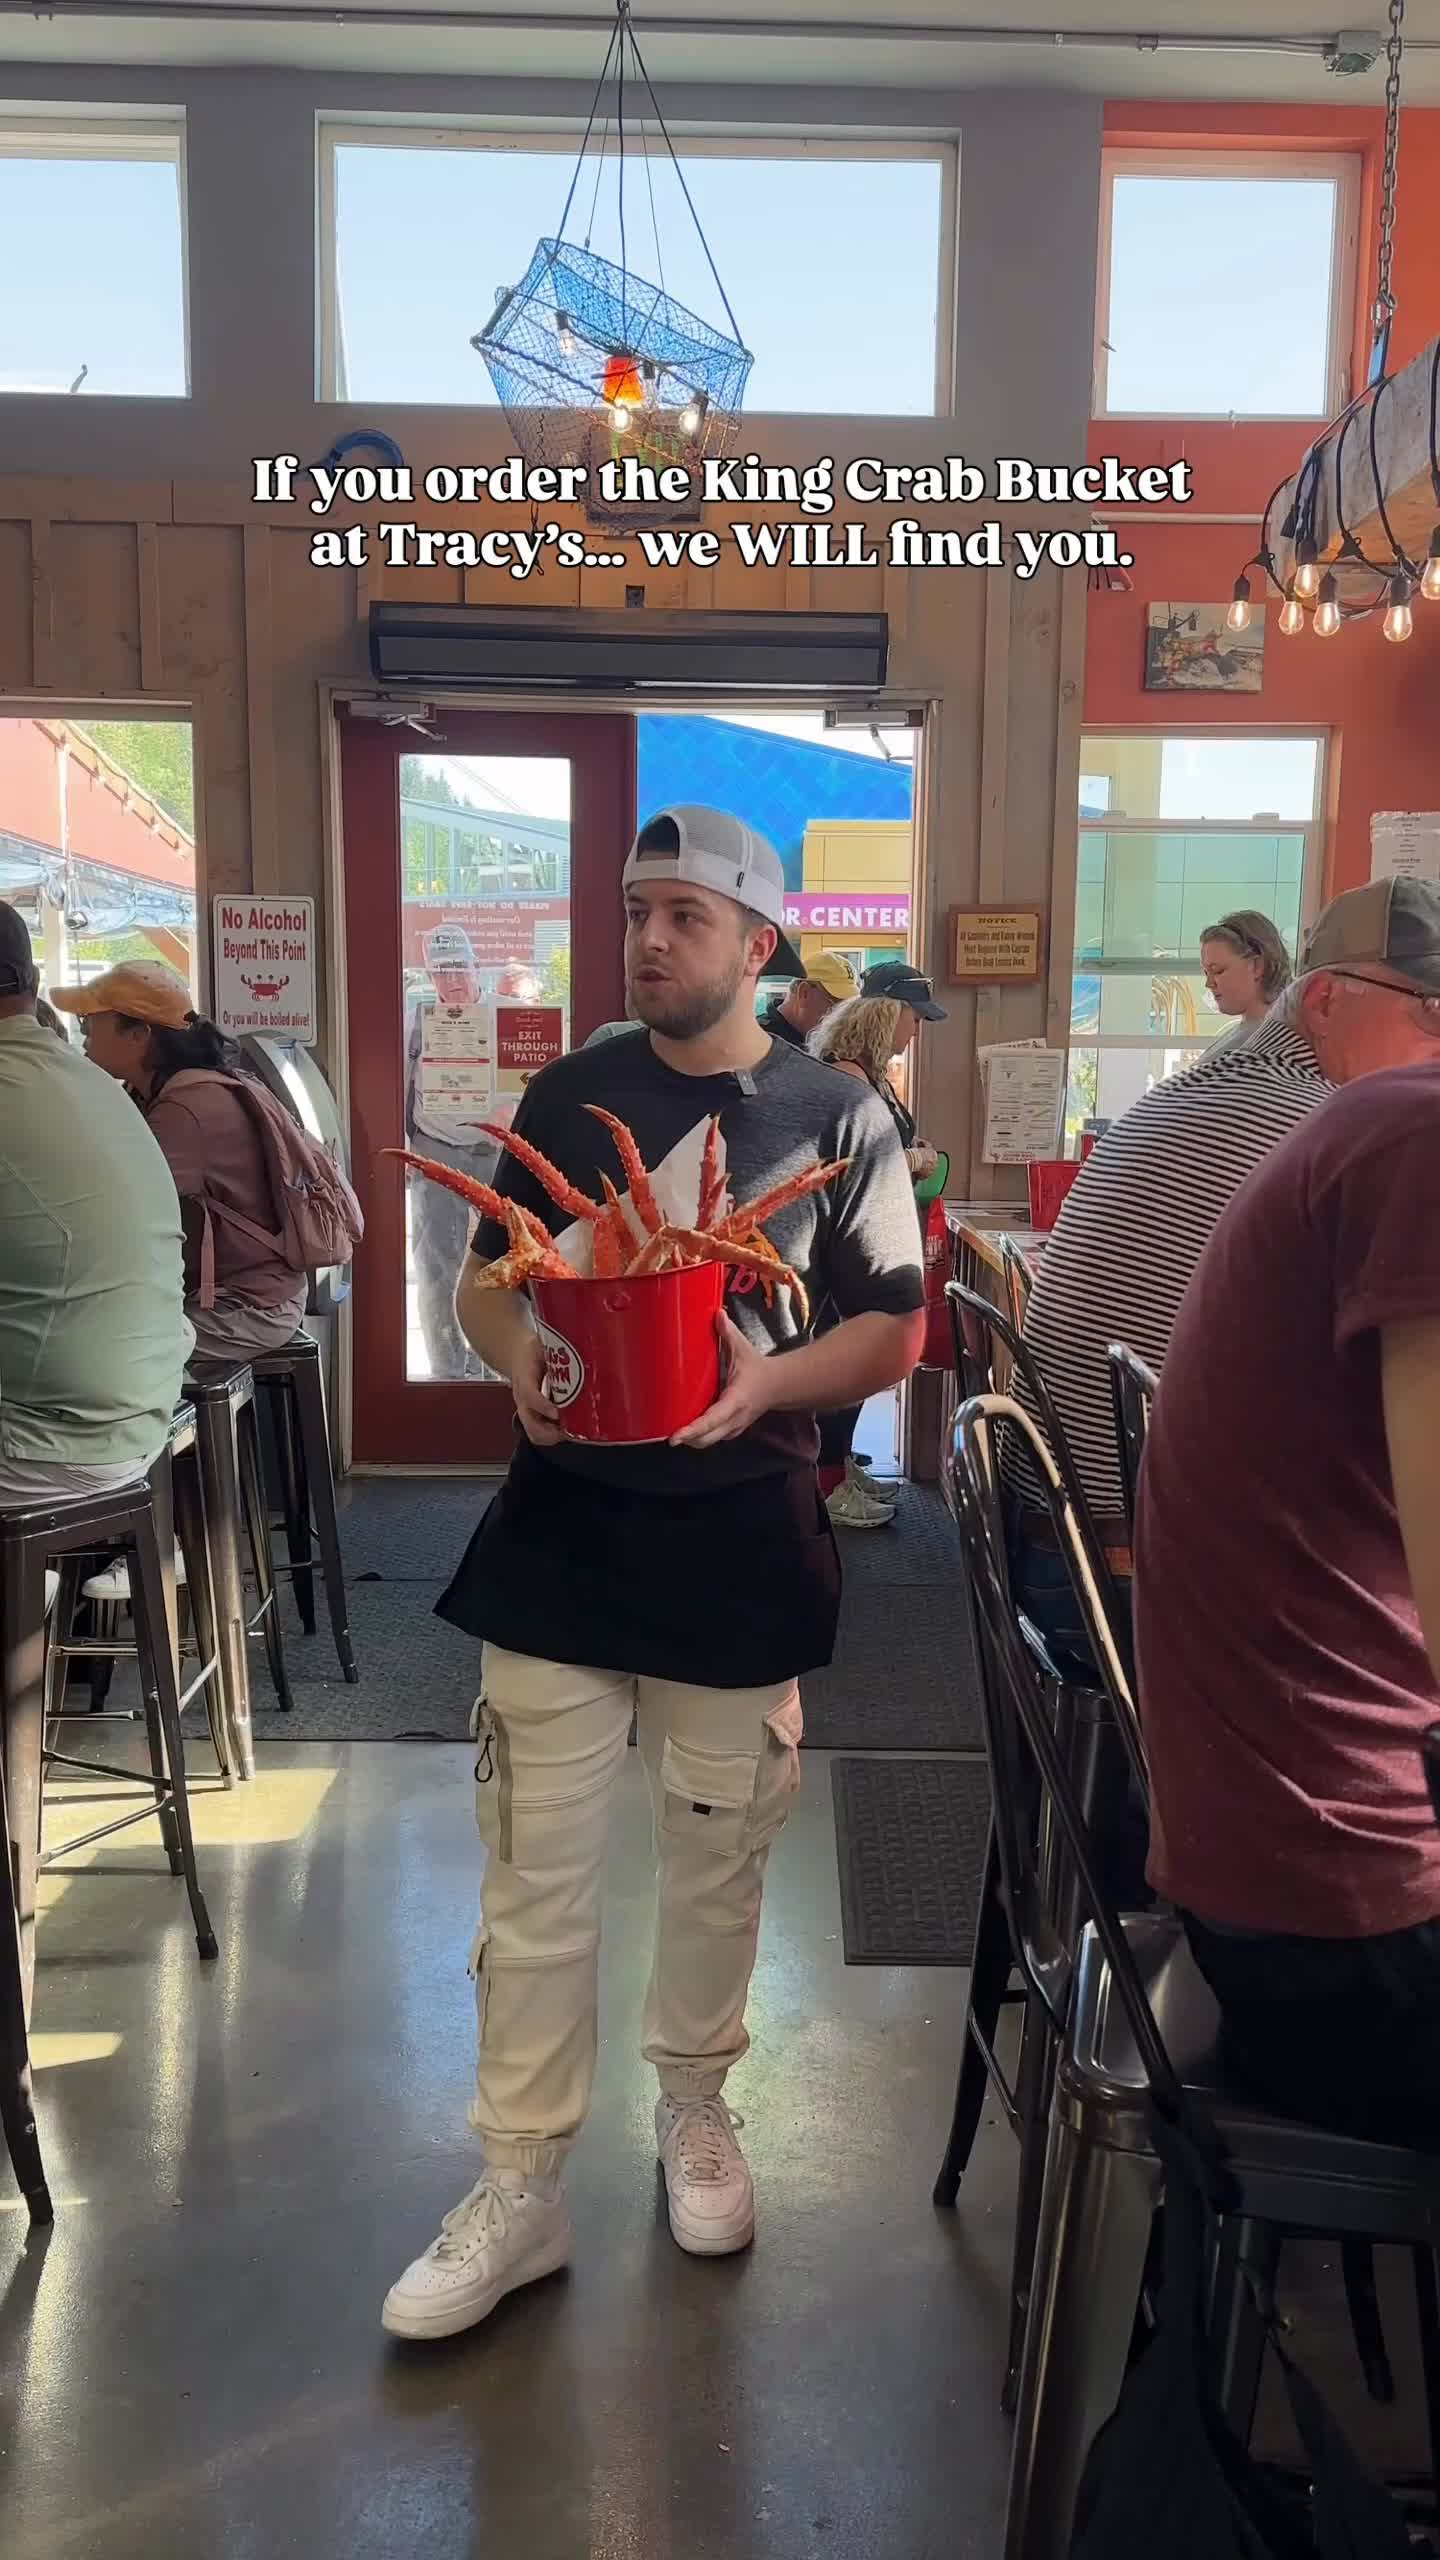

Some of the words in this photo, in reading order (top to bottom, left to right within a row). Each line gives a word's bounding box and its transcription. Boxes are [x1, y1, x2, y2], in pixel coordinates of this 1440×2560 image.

[222, 907, 243, 929] No
[248, 908, 307, 931] Alcohol
[810, 907, 909, 928] CENTER
[224, 938, 258, 965] Beyond
[260, 938, 280, 960] This
[282, 939, 306, 961] Point
[223, 1010, 232, 1025] Or
[233, 1015, 246, 1028] you
[247, 1011, 258, 1025] will
[260, 1011, 269, 1025] be
[270, 1011, 290, 1026] boiled
[518, 1031, 542, 1040] EXIT
[502, 1042, 558, 1051] THROUGH
[513, 1053, 548, 1062] PATIO
